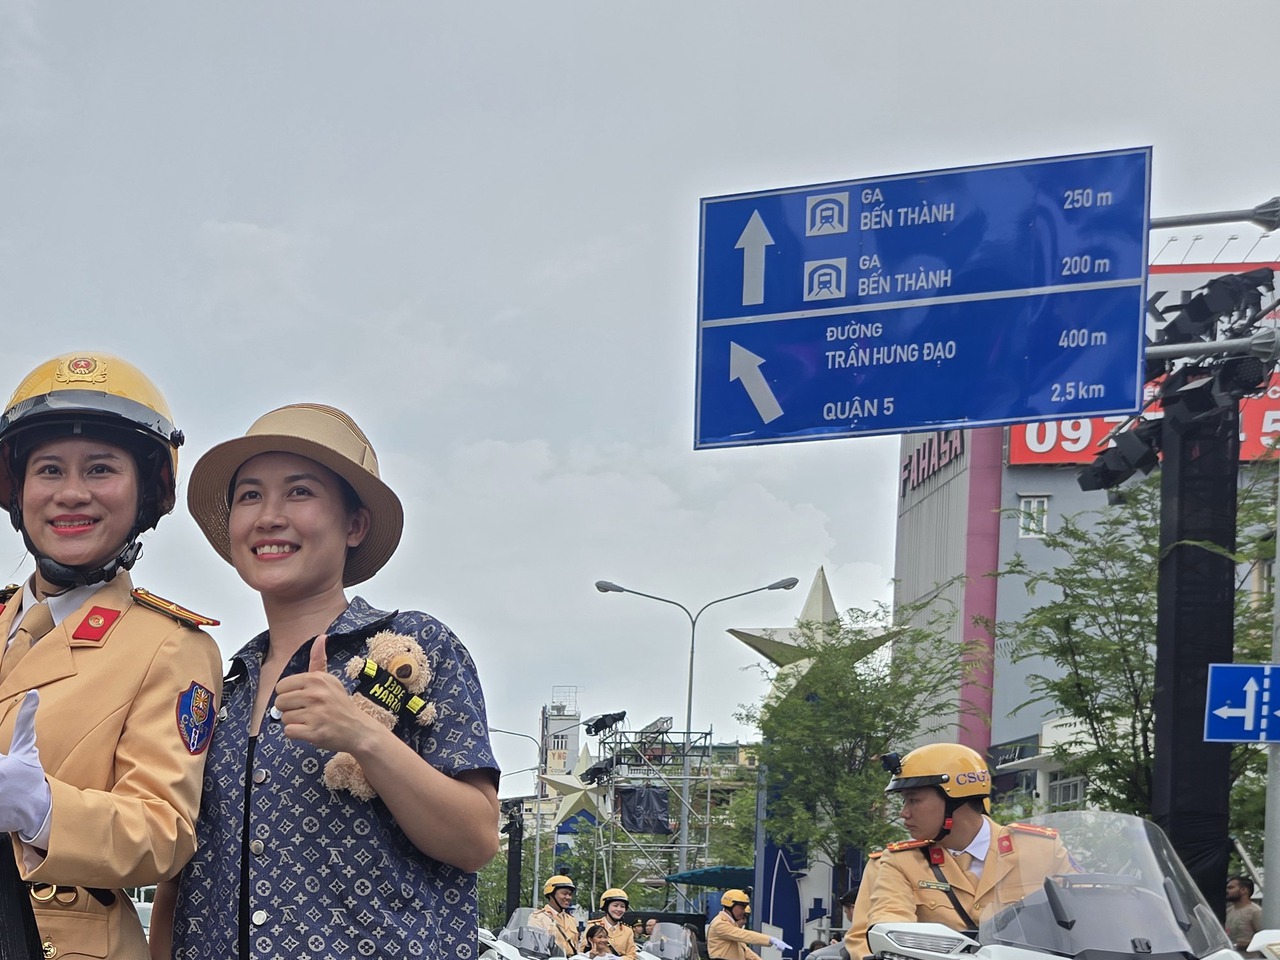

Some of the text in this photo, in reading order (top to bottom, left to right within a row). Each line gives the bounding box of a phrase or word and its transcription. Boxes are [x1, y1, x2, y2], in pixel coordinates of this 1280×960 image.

[861, 188, 884, 204] GA
[1063, 188, 1112, 210] 250 m
[860, 200, 955, 231] BẾN THÀNH
[859, 254, 881, 270] GA
[1062, 255, 1110, 276] 200 m
[858, 266, 952, 296] BẾN THÀNH
[826, 320, 883, 342] ĐƯỜNG
[1058, 328, 1107, 348] 400 m
[825, 340, 956, 369] TRẦN HƯNG ĐẠO
[1050, 381, 1105, 402] 2,5 km
[823, 396, 894, 424] QUẬN 5
[901, 429, 963, 498] FAHASA
